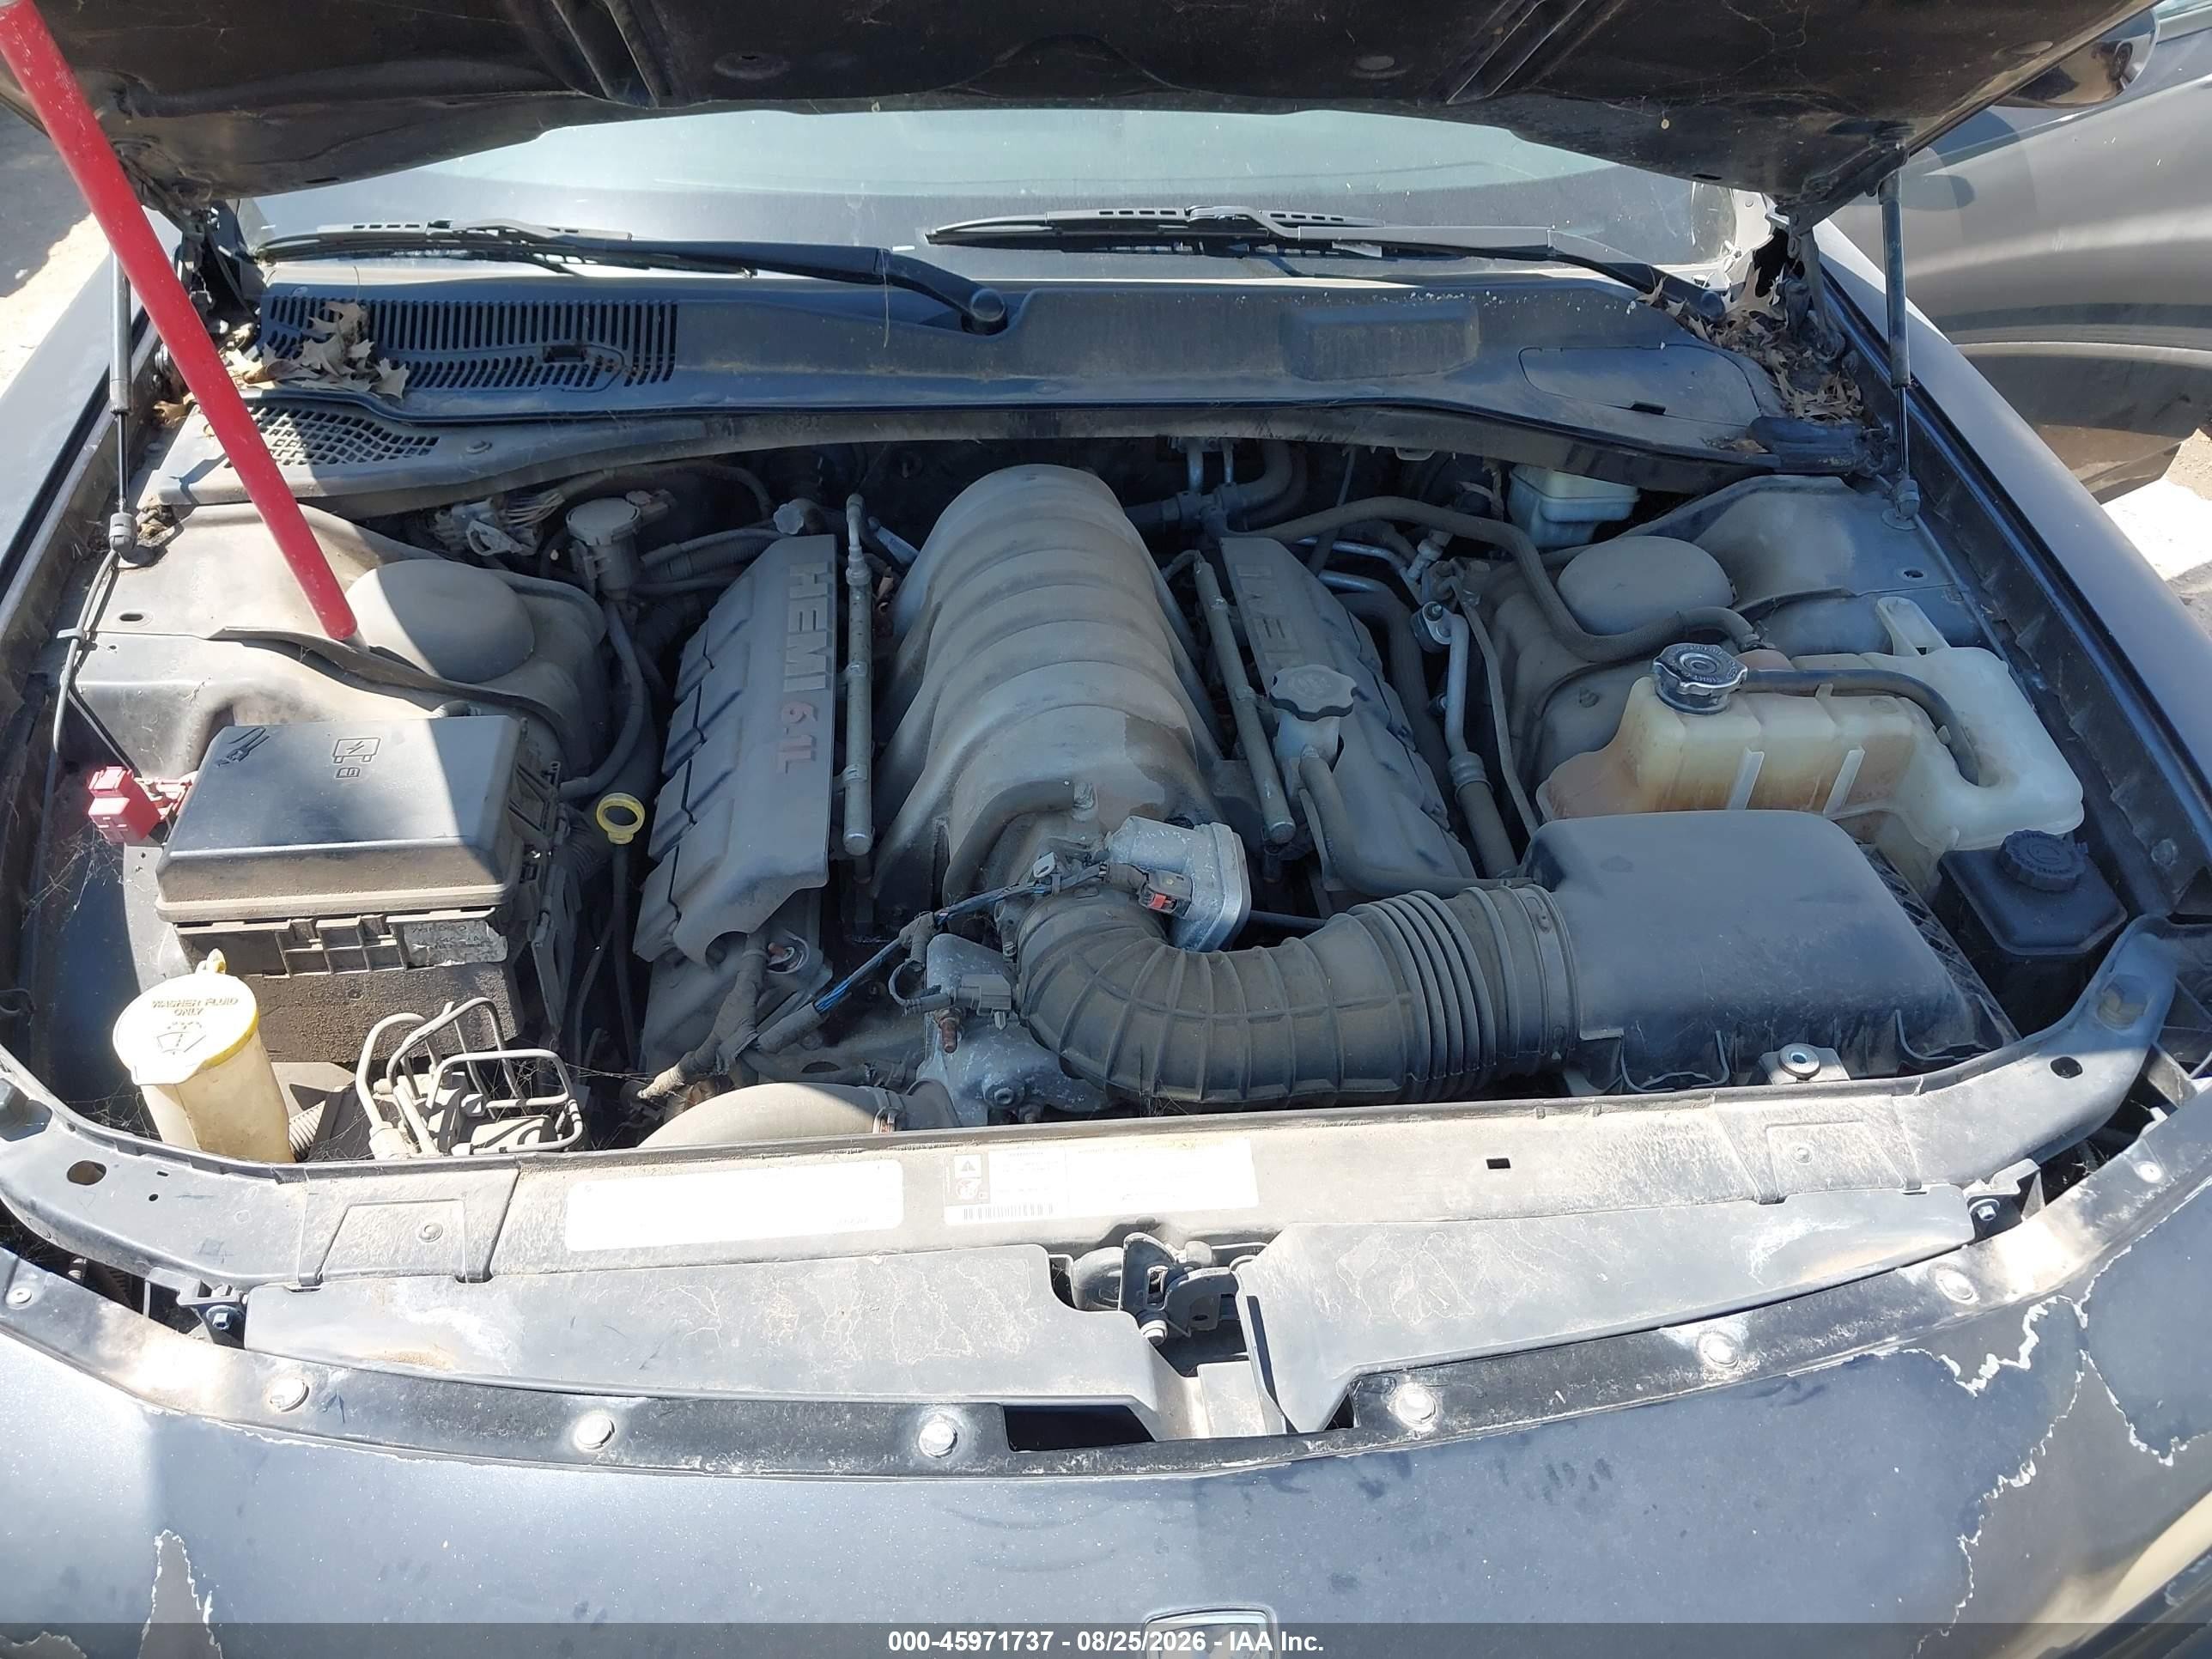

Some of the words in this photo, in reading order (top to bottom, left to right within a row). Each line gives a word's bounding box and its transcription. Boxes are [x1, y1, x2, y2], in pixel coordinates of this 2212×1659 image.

[783, 562, 832, 692] HEMI
[776, 700, 817, 775] 6.1L
[174, 1008, 204, 1017] ONLY
[204, 997, 239, 1007] FLUID
